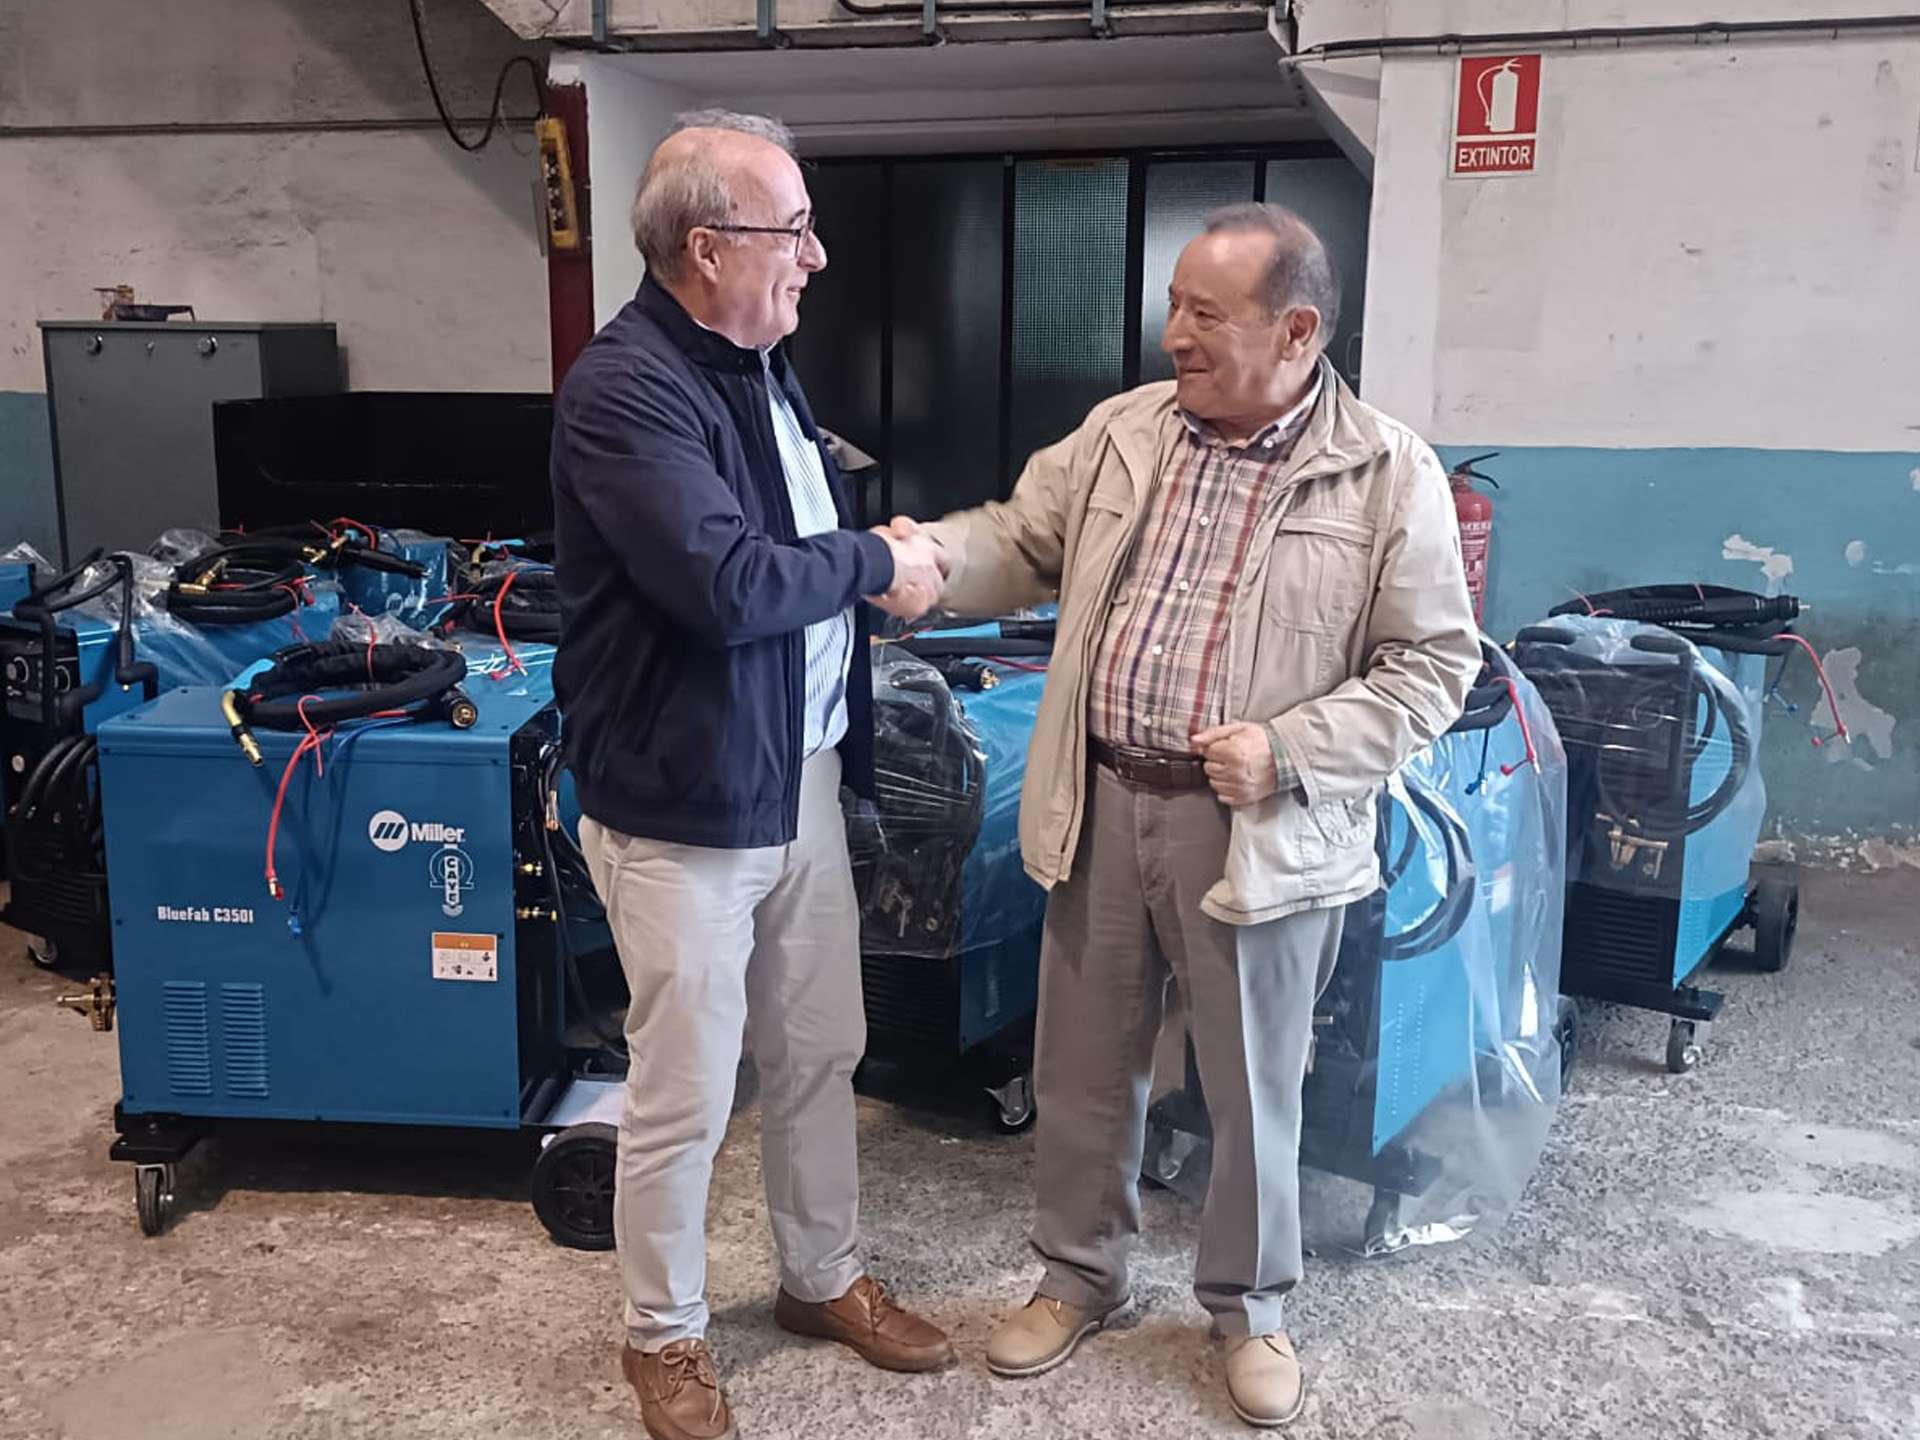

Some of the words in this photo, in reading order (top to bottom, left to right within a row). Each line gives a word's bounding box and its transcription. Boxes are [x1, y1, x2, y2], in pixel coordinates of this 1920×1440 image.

[1458, 146, 1530, 167] EXTINTOR
[411, 822, 465, 842] Miller
[157, 906, 210, 921] BlueFab
